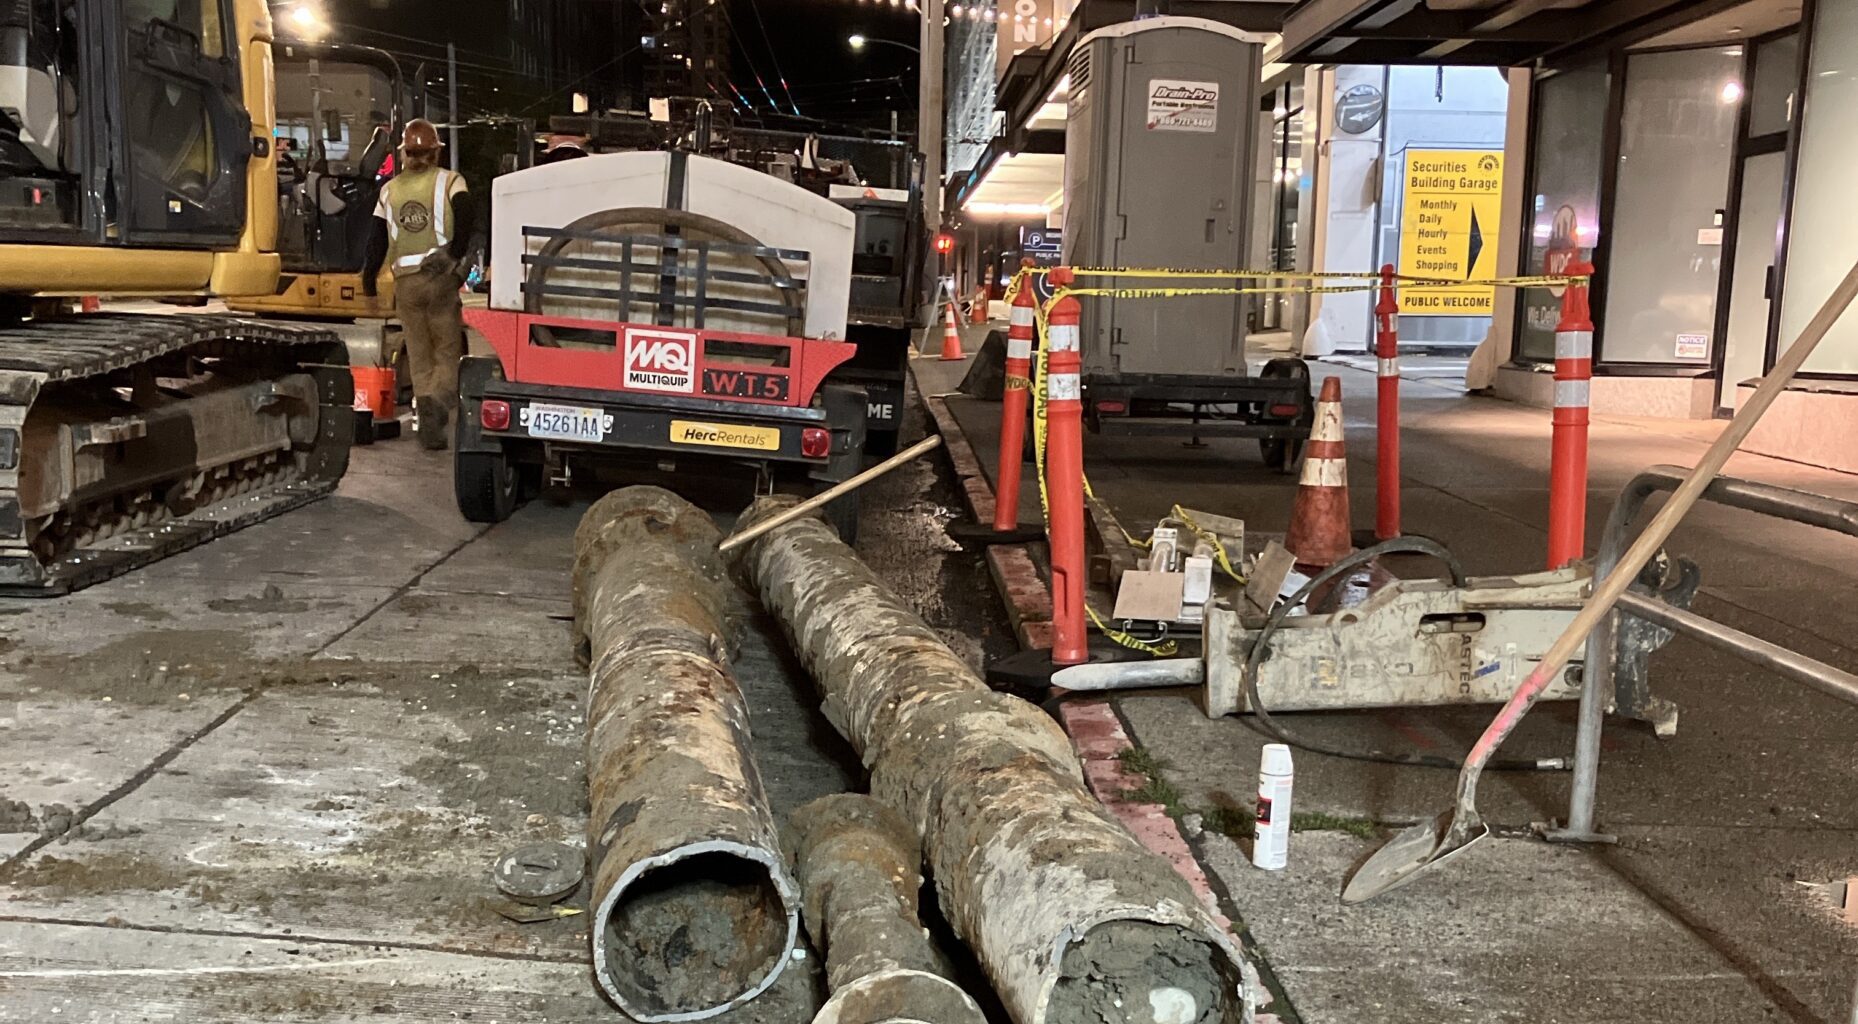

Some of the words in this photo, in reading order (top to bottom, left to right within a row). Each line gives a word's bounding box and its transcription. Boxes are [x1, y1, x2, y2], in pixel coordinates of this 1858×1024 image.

[1152, 86, 1216, 101] Drain-Pro
[1412, 161, 1467, 173] Securities
[1411, 177, 1455, 190] Building
[1459, 177, 1498, 191] Garage
[1420, 200, 1457, 211] Monthly
[1419, 214, 1442, 225] Daily
[1418, 229, 1447, 240] Hourly
[1417, 245, 1447, 255] Events
[1416, 260, 1458, 271] Shopping
[1405, 296, 1439, 307] PUBLIC
[1443, 297, 1491, 307] WELCOME
[629, 339, 689, 373] MQ
[629, 372, 688, 387] MULTIQUIP
[533, 413, 598, 436] 45261AA
[1459, 634, 1471, 694] ASTEC
